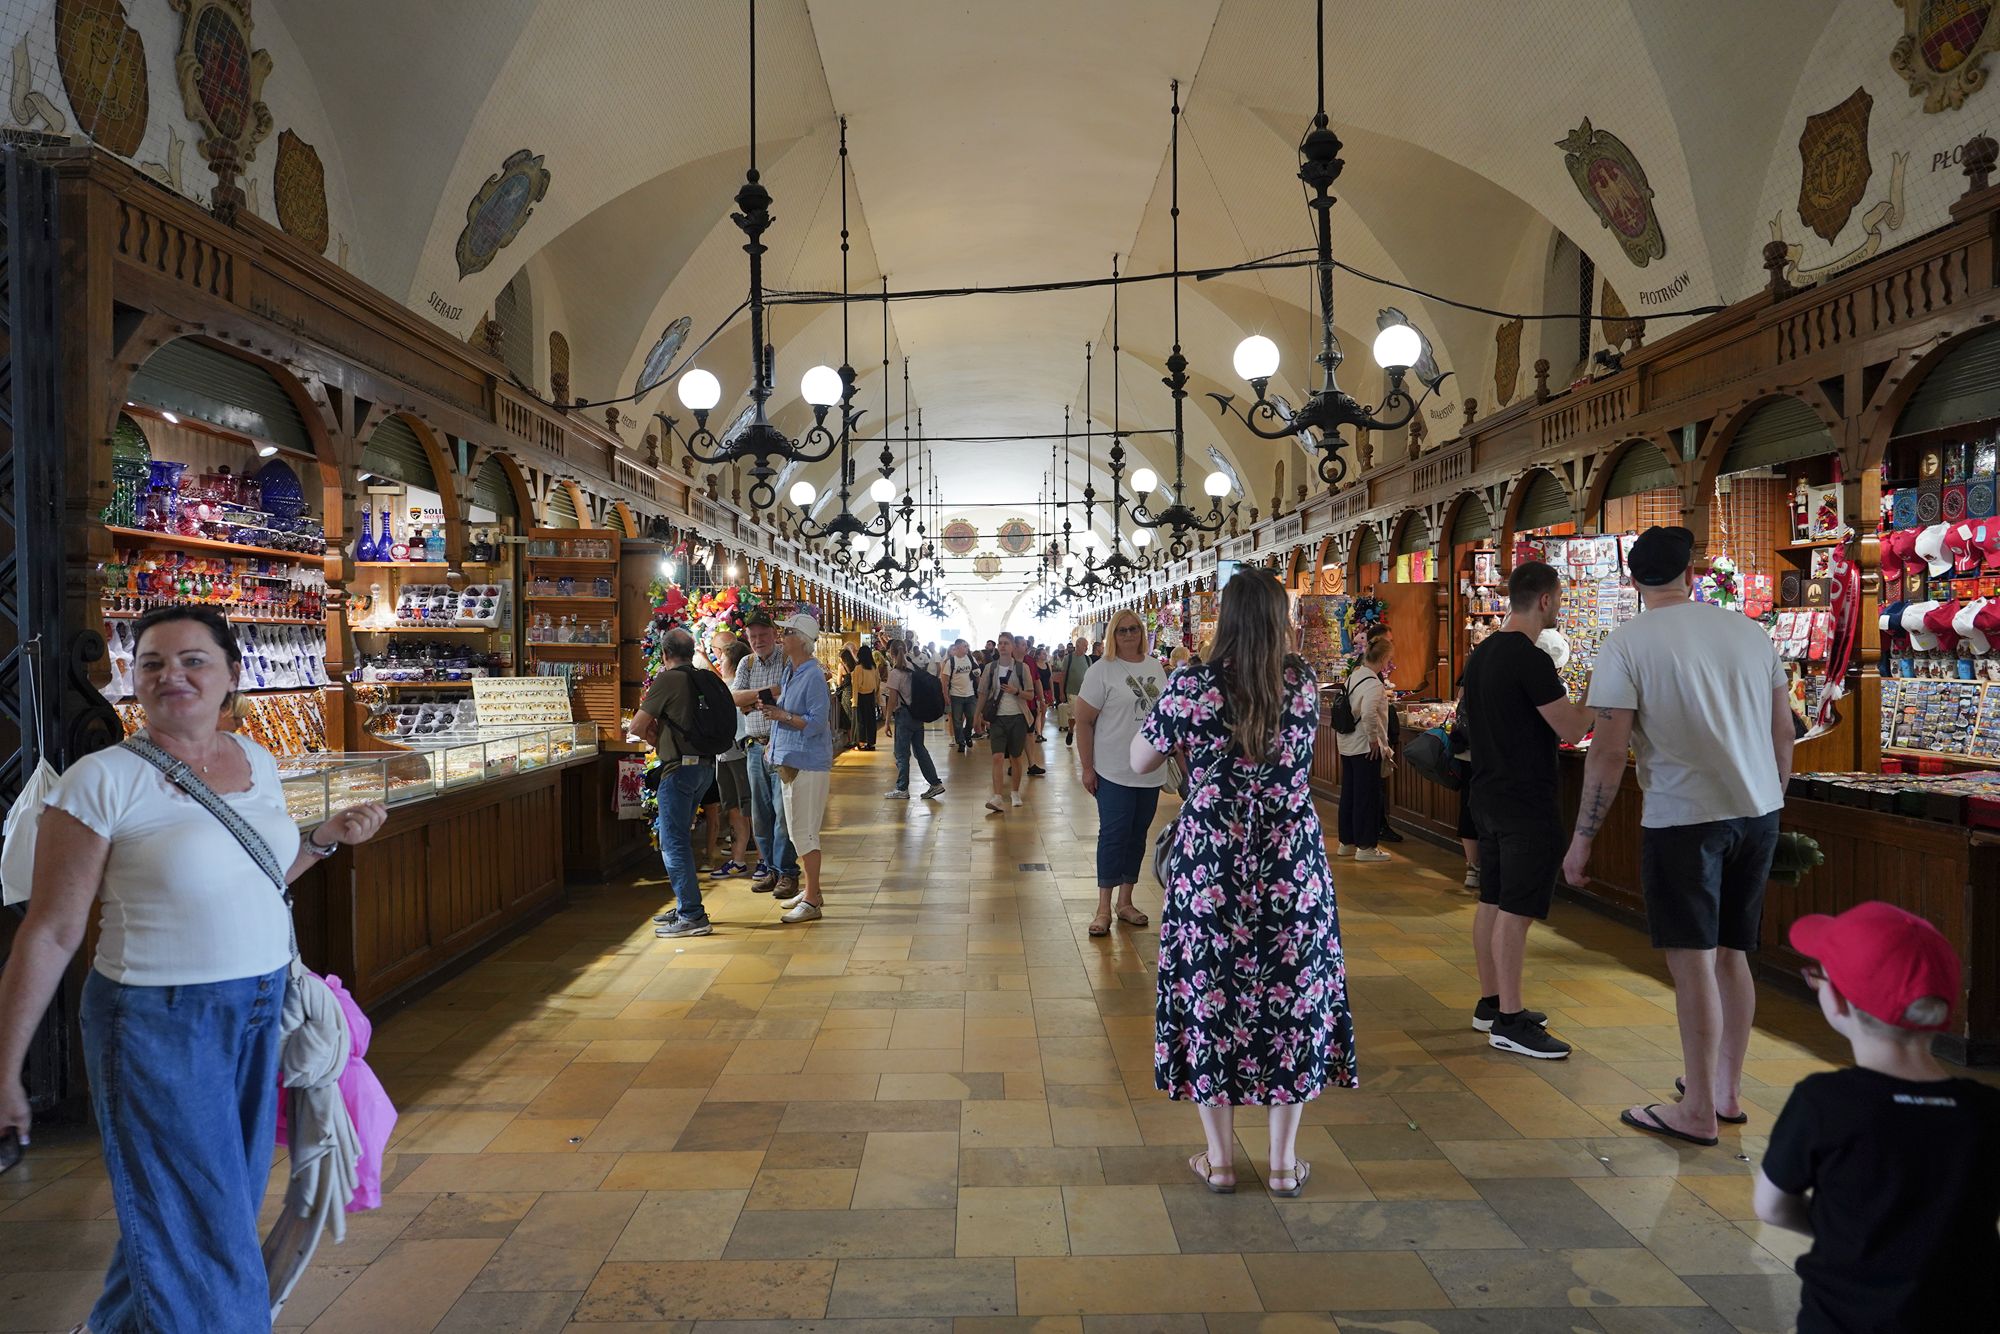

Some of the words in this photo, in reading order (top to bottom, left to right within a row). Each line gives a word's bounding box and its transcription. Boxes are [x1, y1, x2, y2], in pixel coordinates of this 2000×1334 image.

[1639, 270, 1691, 305] PIOTRKÓW
[427, 290, 463, 321] SIERADZ
[1683, 429, 1696, 456] 41
